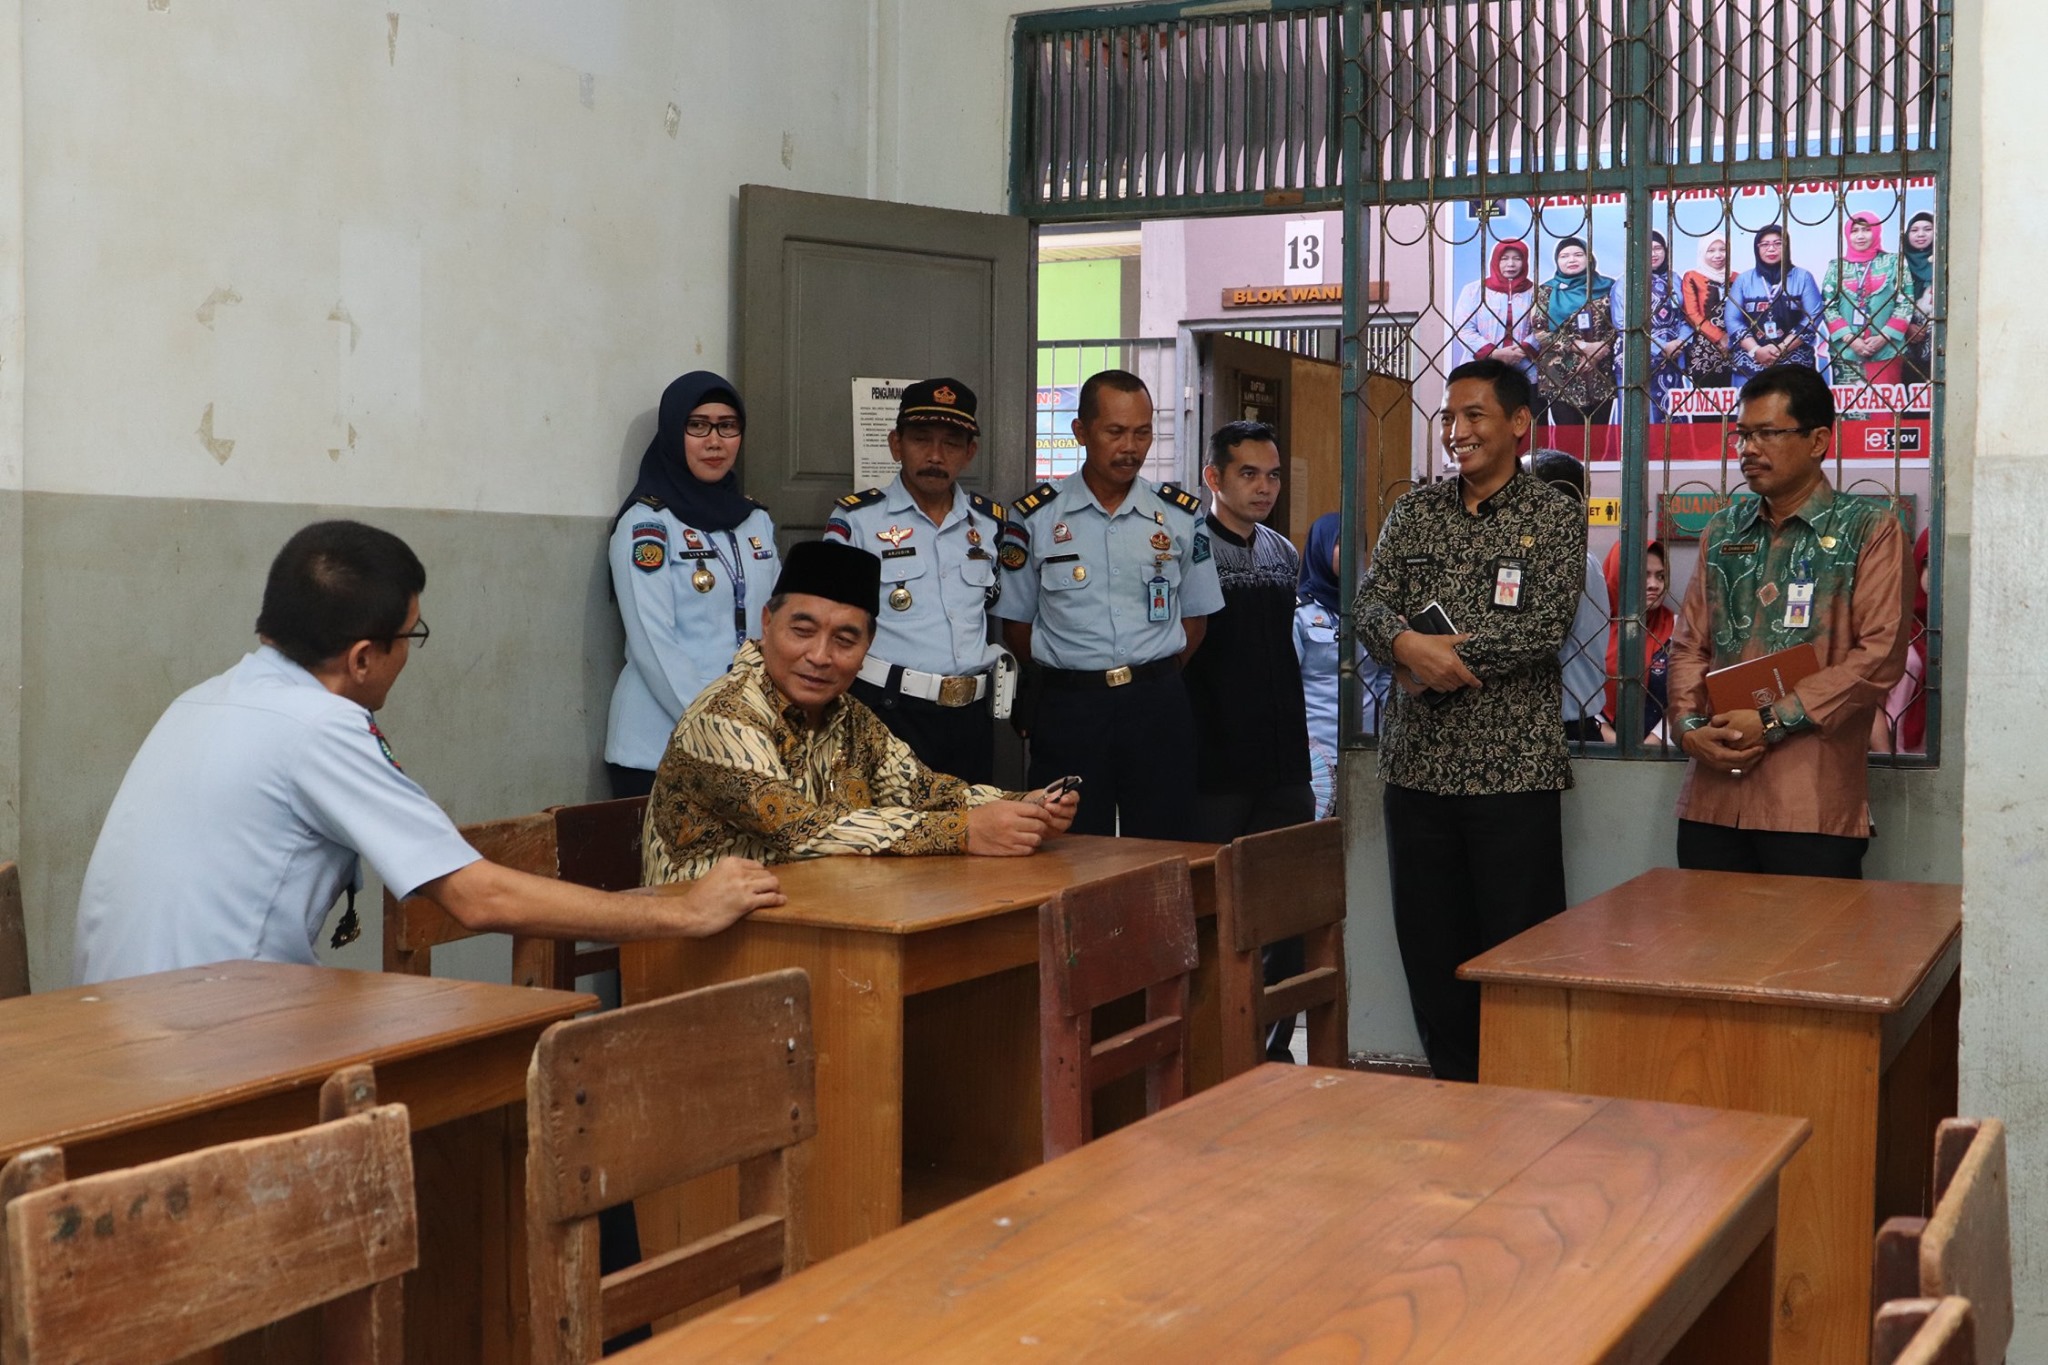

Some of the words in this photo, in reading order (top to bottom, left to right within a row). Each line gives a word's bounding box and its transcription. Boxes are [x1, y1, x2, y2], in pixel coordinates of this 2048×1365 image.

[1287, 234, 1320, 270] 13
[1233, 287, 1288, 304] BLOK
[1290, 286, 1343, 302] WANI
[1036, 391, 1062, 406] NG
[1671, 390, 1735, 412] RUMAH
[1831, 386, 1907, 410] NEGARA
[1036, 438, 1080, 449] DANGAN
[1589, 506, 1601, 516] ET
